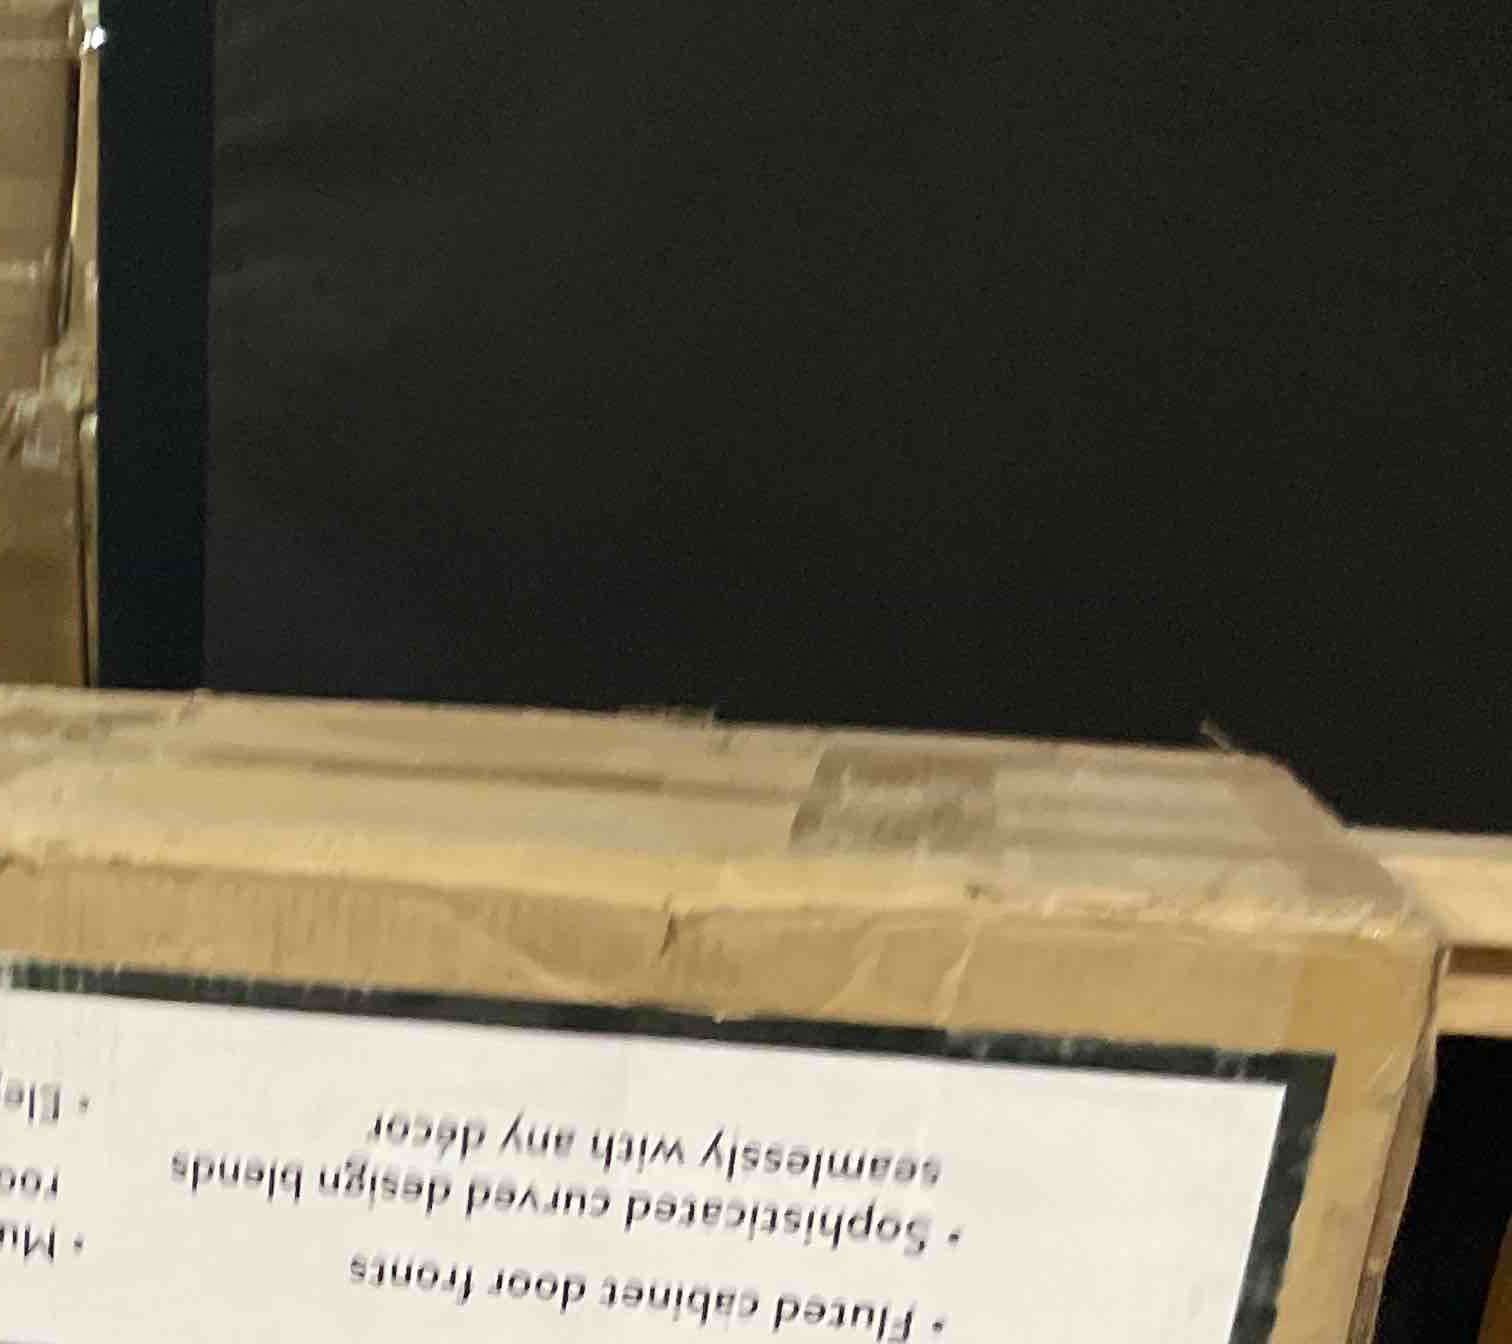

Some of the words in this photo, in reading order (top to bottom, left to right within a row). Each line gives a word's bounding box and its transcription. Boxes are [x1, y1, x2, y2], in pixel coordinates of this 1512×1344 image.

[367, 1112, 486, 1161] décor
[497, 1112, 576, 1160] any
[590, 1132, 685, 1174] with
[700, 1128, 942, 1193] seamlessly
[171, 1151, 304, 1203] blends
[318, 1158, 452, 1216] design
[466, 1181, 612, 1225] curved
[626, 1192, 931, 1258] Sophisticated
[348, 1256, 475, 1306] fronts
[486, 1269, 587, 1314] door
[599, 1279, 760, 1332] cabinet
[774, 1296, 915, 1344] Fluted
